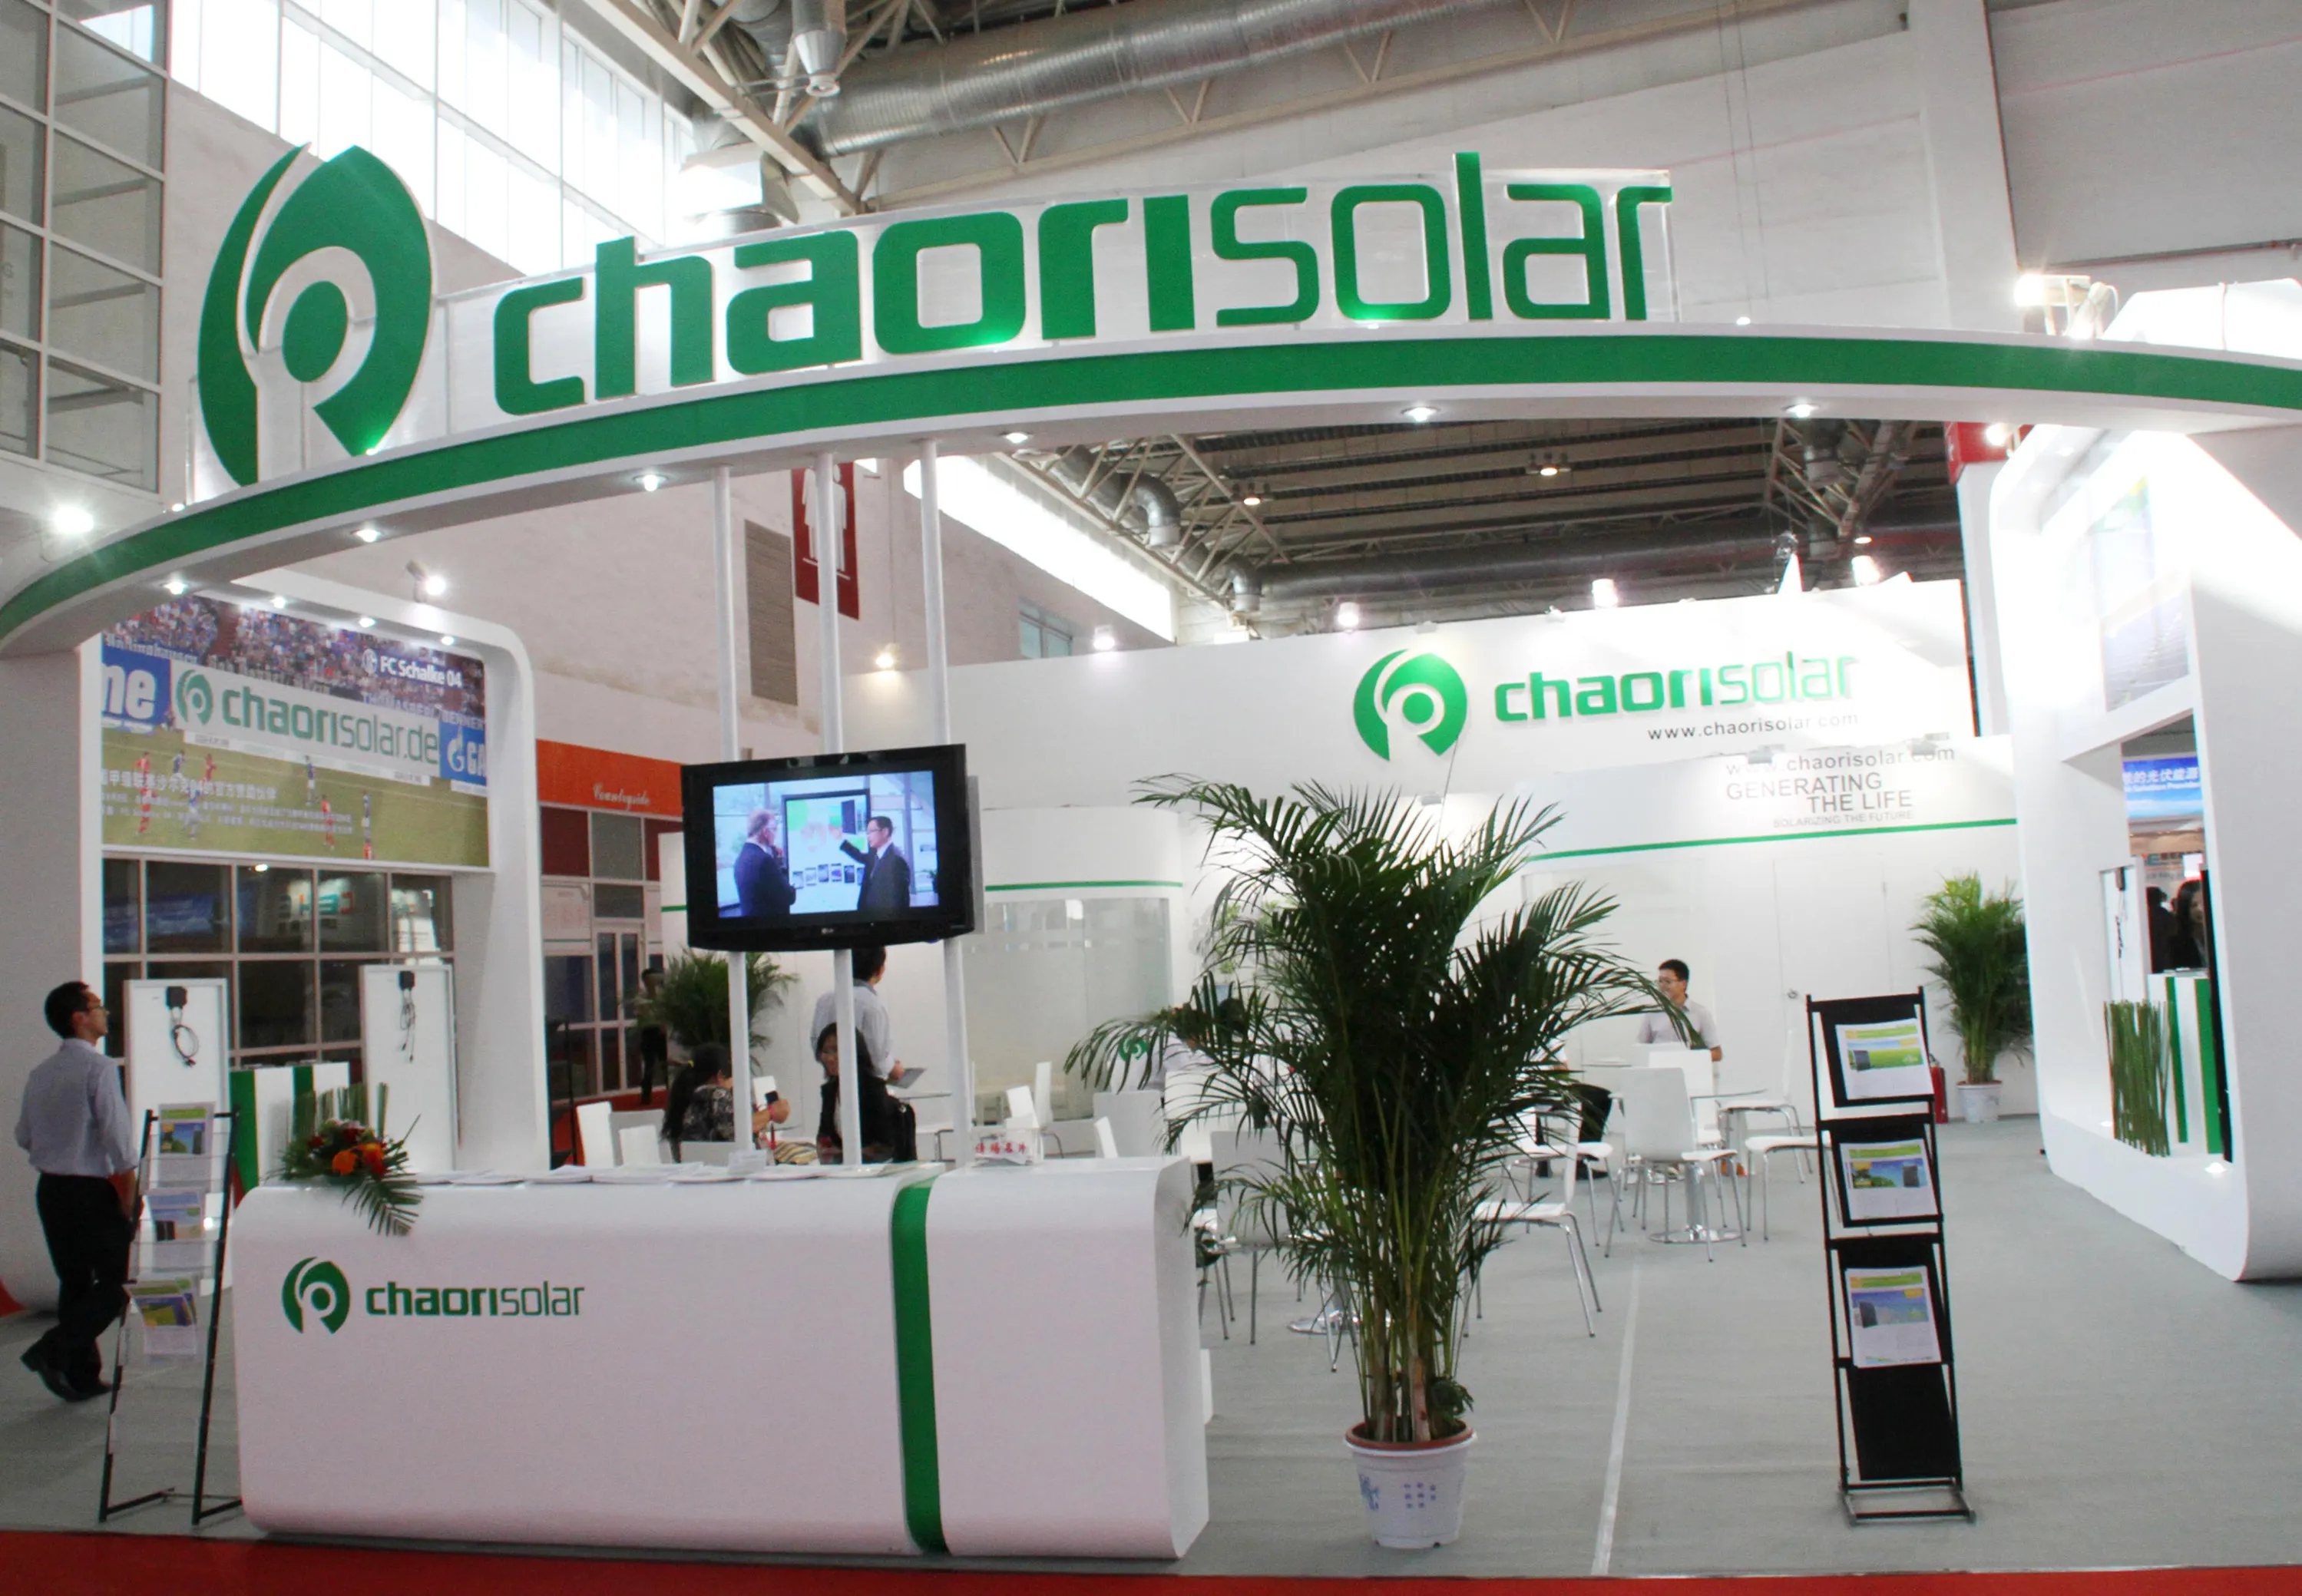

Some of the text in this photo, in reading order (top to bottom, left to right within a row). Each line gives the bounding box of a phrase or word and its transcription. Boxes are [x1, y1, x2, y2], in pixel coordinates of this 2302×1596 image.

[493, 151, 1673, 415] chaorisolar
[380, 656, 462, 688] FC Schalke 04
[1495, 650, 1855, 722] chaorisolar
[222, 686, 438, 765] chaorisolar.de
[1647, 713, 1859, 740] www.chaorisolarcom
[1726, 772, 1882, 801] GENERATING
[1808, 790, 1913, 814] THE LIFE
[1844, 813, 1866, 824] THE
[1869, 809, 1913, 822] FUTURE
[366, 1280, 584, 1317] chaorisolar
